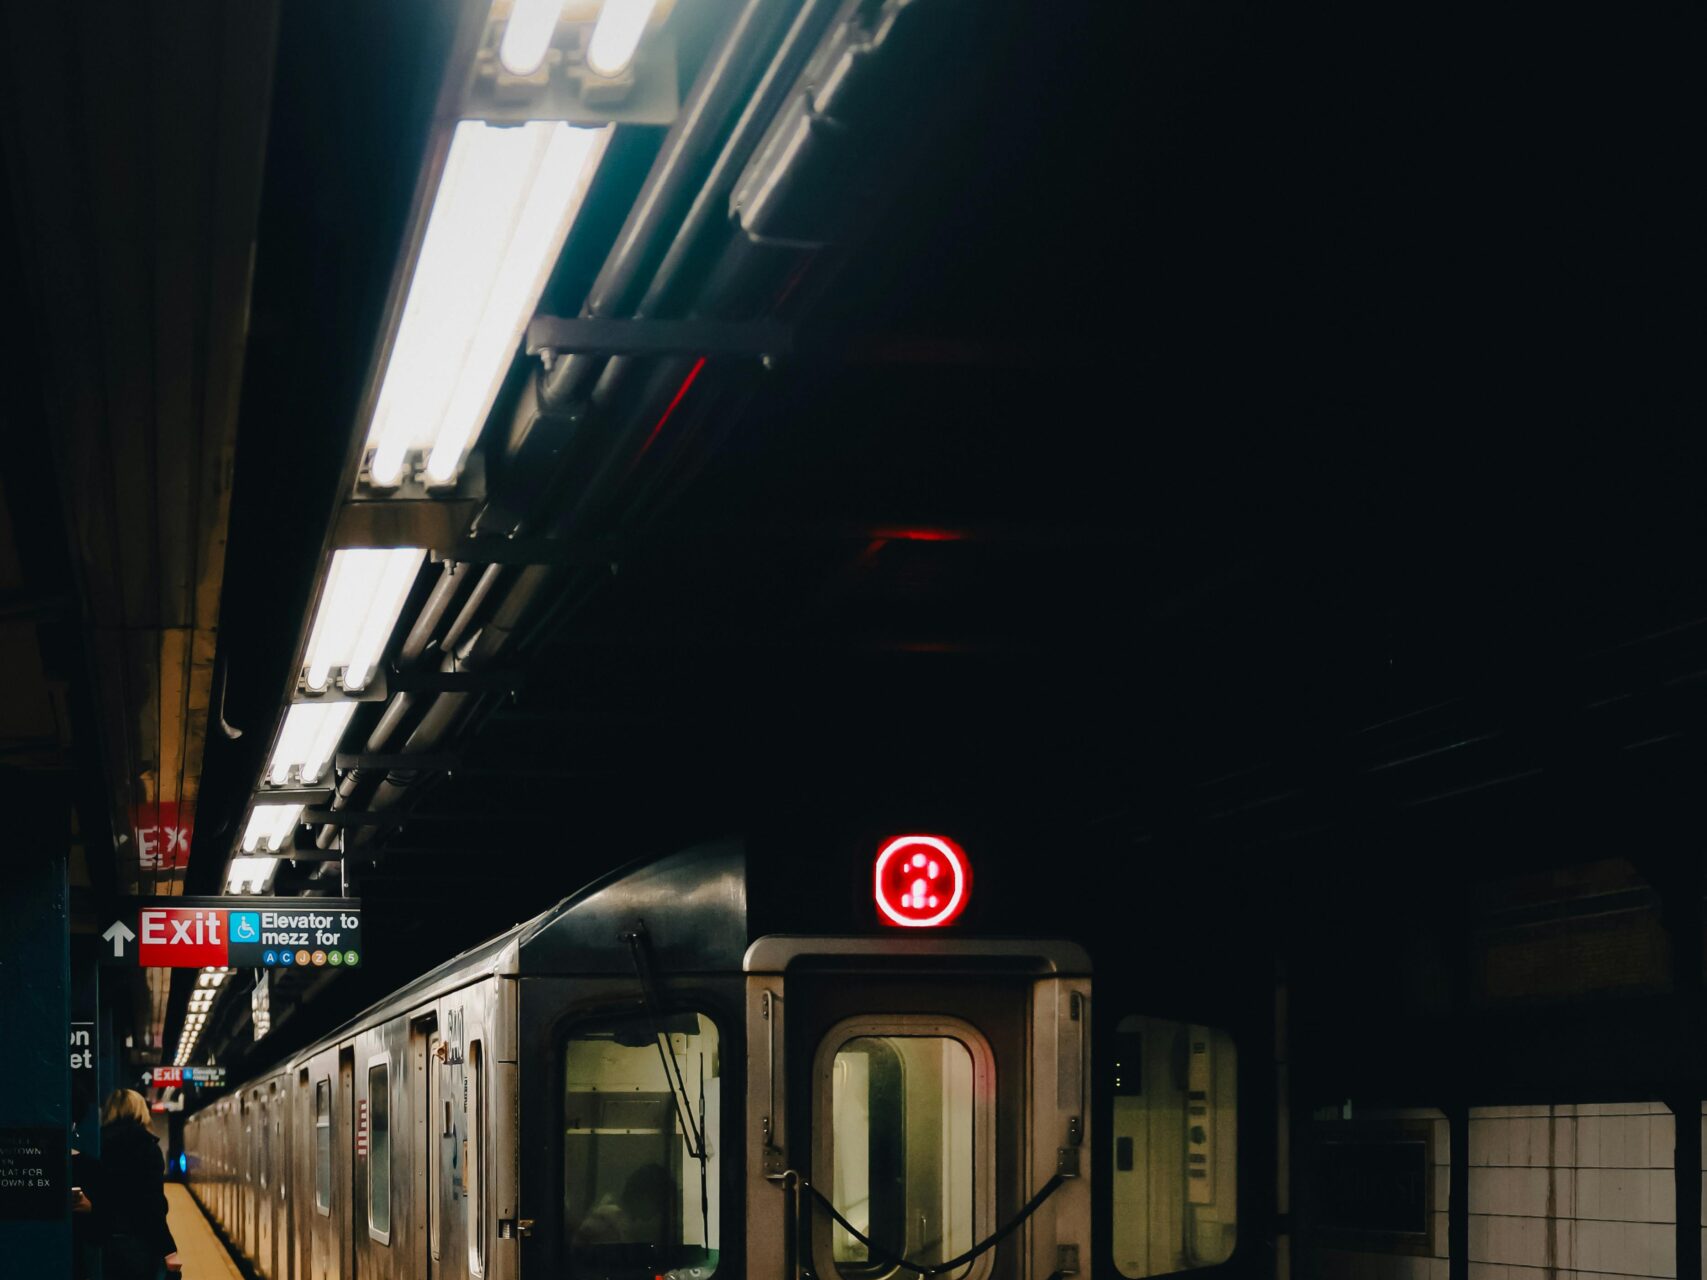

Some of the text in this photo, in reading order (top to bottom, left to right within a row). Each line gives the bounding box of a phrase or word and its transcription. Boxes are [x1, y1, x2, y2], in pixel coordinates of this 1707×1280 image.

[901, 853, 939, 909] 2
[141, 911, 221, 945] Exit
[261, 912, 359, 929] Elevator to
[262, 929, 341, 945] mezz for
[154, 1068, 182, 1081] Exit
[22, 1168, 43, 1176] FOR
[37, 1179, 50, 1187] BX
